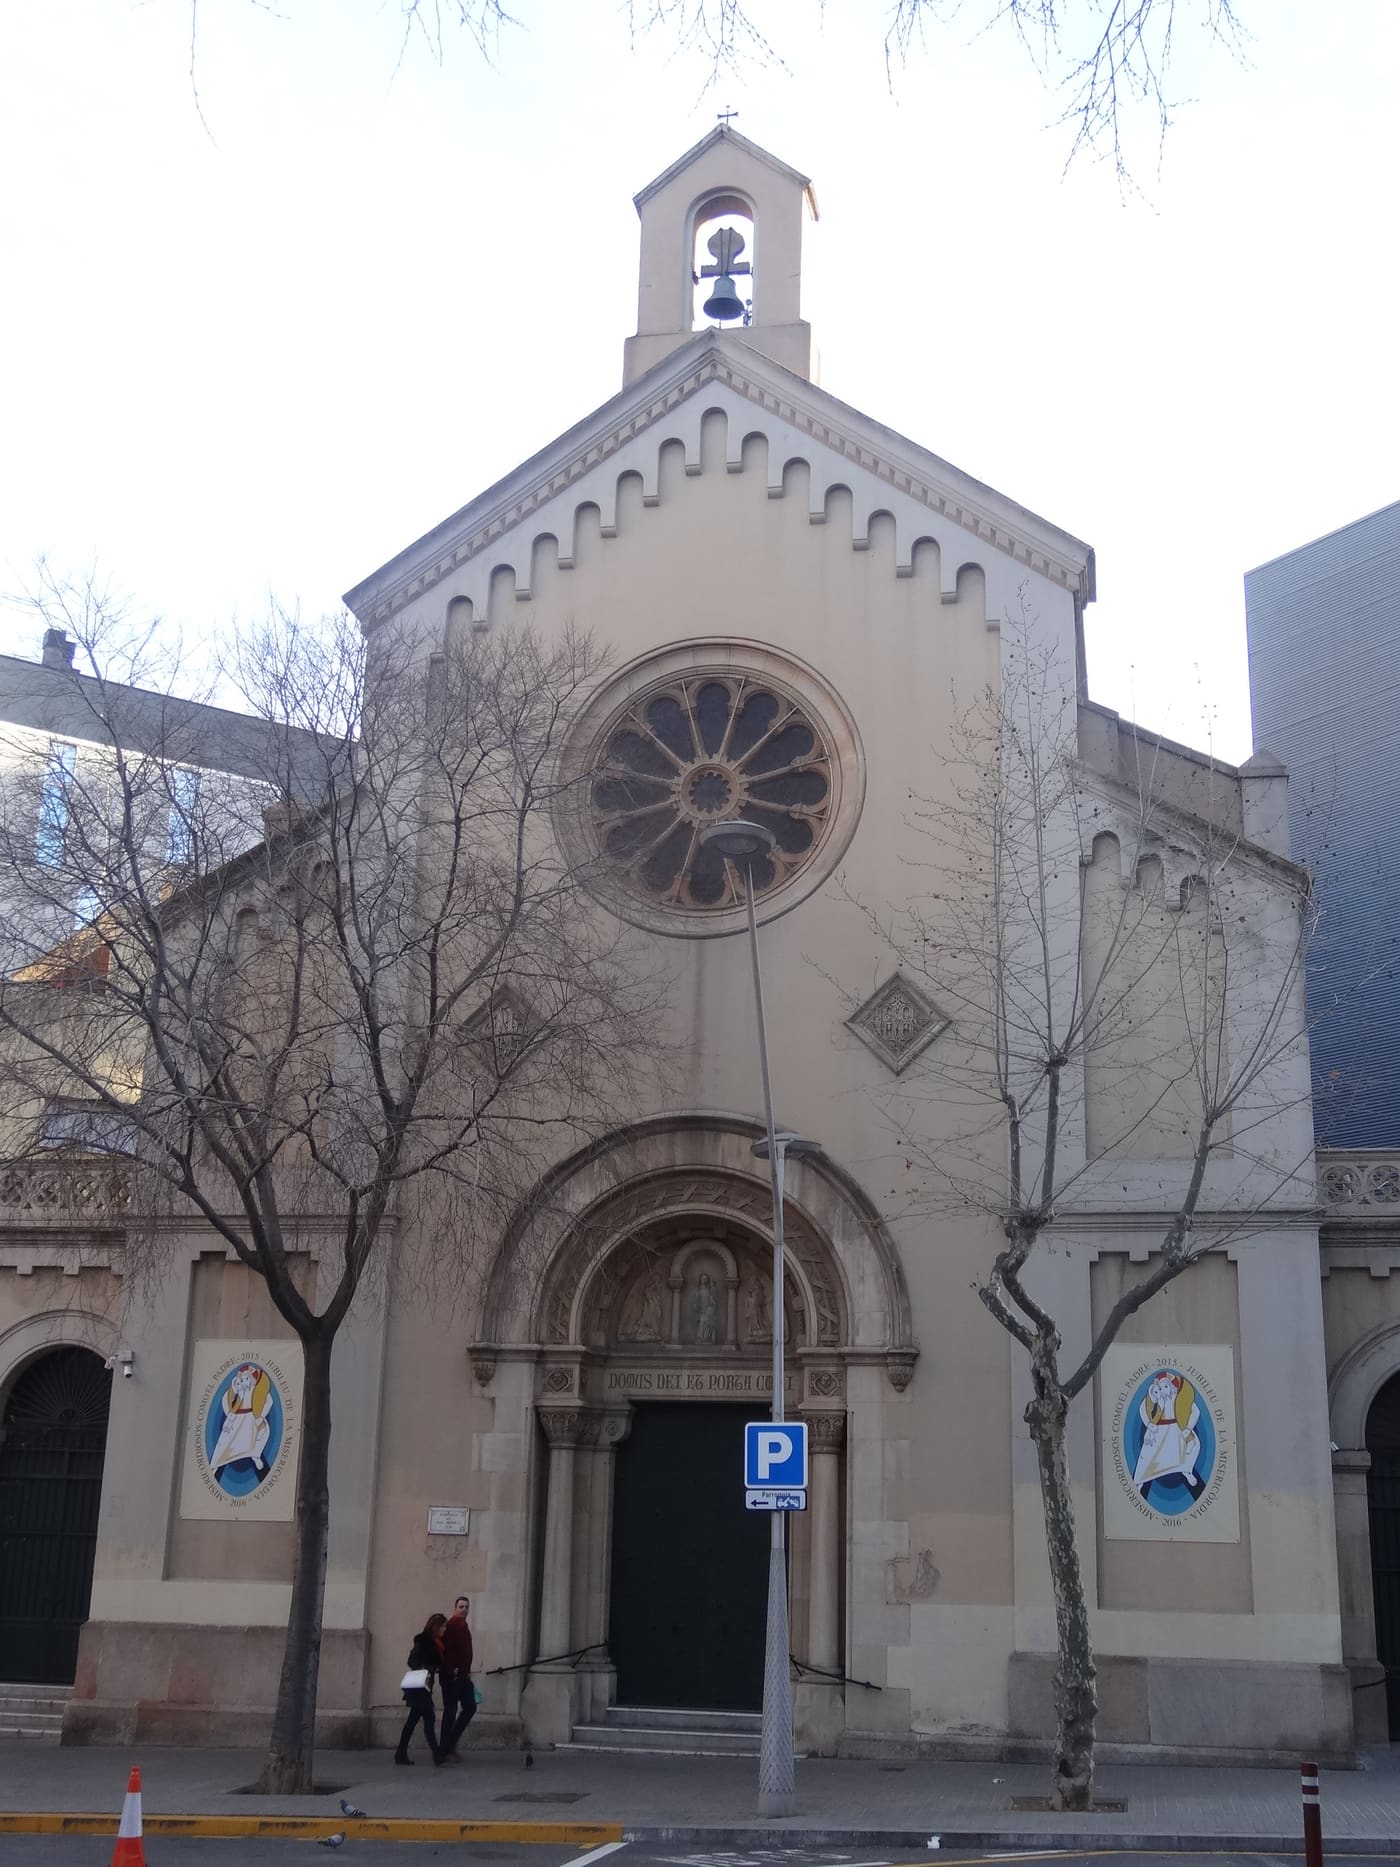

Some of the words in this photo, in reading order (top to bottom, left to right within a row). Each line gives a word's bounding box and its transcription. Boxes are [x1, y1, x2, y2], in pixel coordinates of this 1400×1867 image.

[212, 1357, 236, 1381] PADRE
[241, 1352, 260, 1361] 2015
[1156, 1358, 1177, 1367] 2015
[1125, 1362, 1151, 1389] PADRE
[1186, 1365, 1218, 1404] JUBILEU
[1214, 1408, 1225, 1423] DE
[1218, 1429, 1227, 1444] LA
[757, 1432, 793, 1479] P
[253, 1436, 293, 1501] MISERICORDIA
[1111, 1436, 1156, 1521] MISERICORDIOSOS
[1190, 1450, 1228, 1520] MISERICORDIA
[1162, 1517, 1182, 1528] 2016
